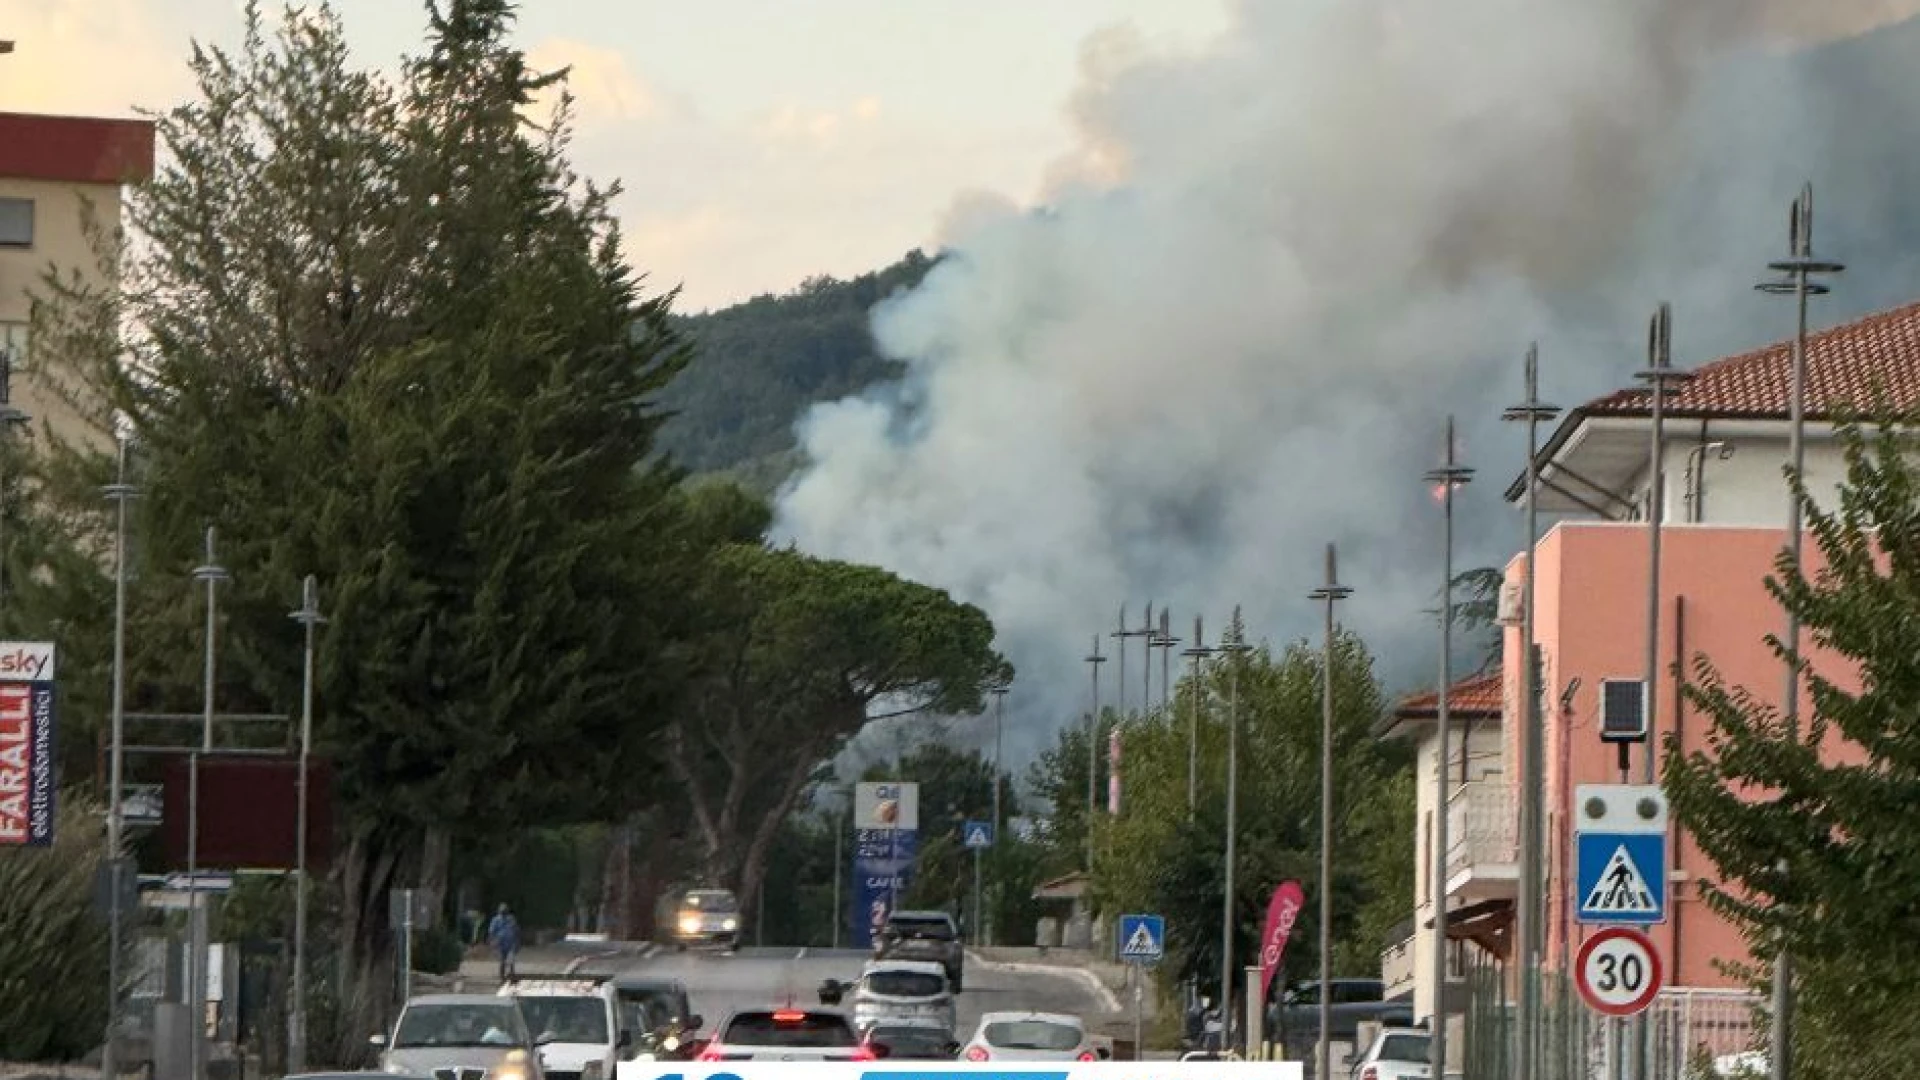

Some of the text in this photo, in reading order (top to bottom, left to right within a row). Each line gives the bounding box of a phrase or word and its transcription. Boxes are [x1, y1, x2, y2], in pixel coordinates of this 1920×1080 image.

[2, 649, 49, 679] sky
[0, 686, 29, 838] FARALLI
[32, 689, 51, 838] elettrodomestici
[1597, 953, 1642, 991] 30
